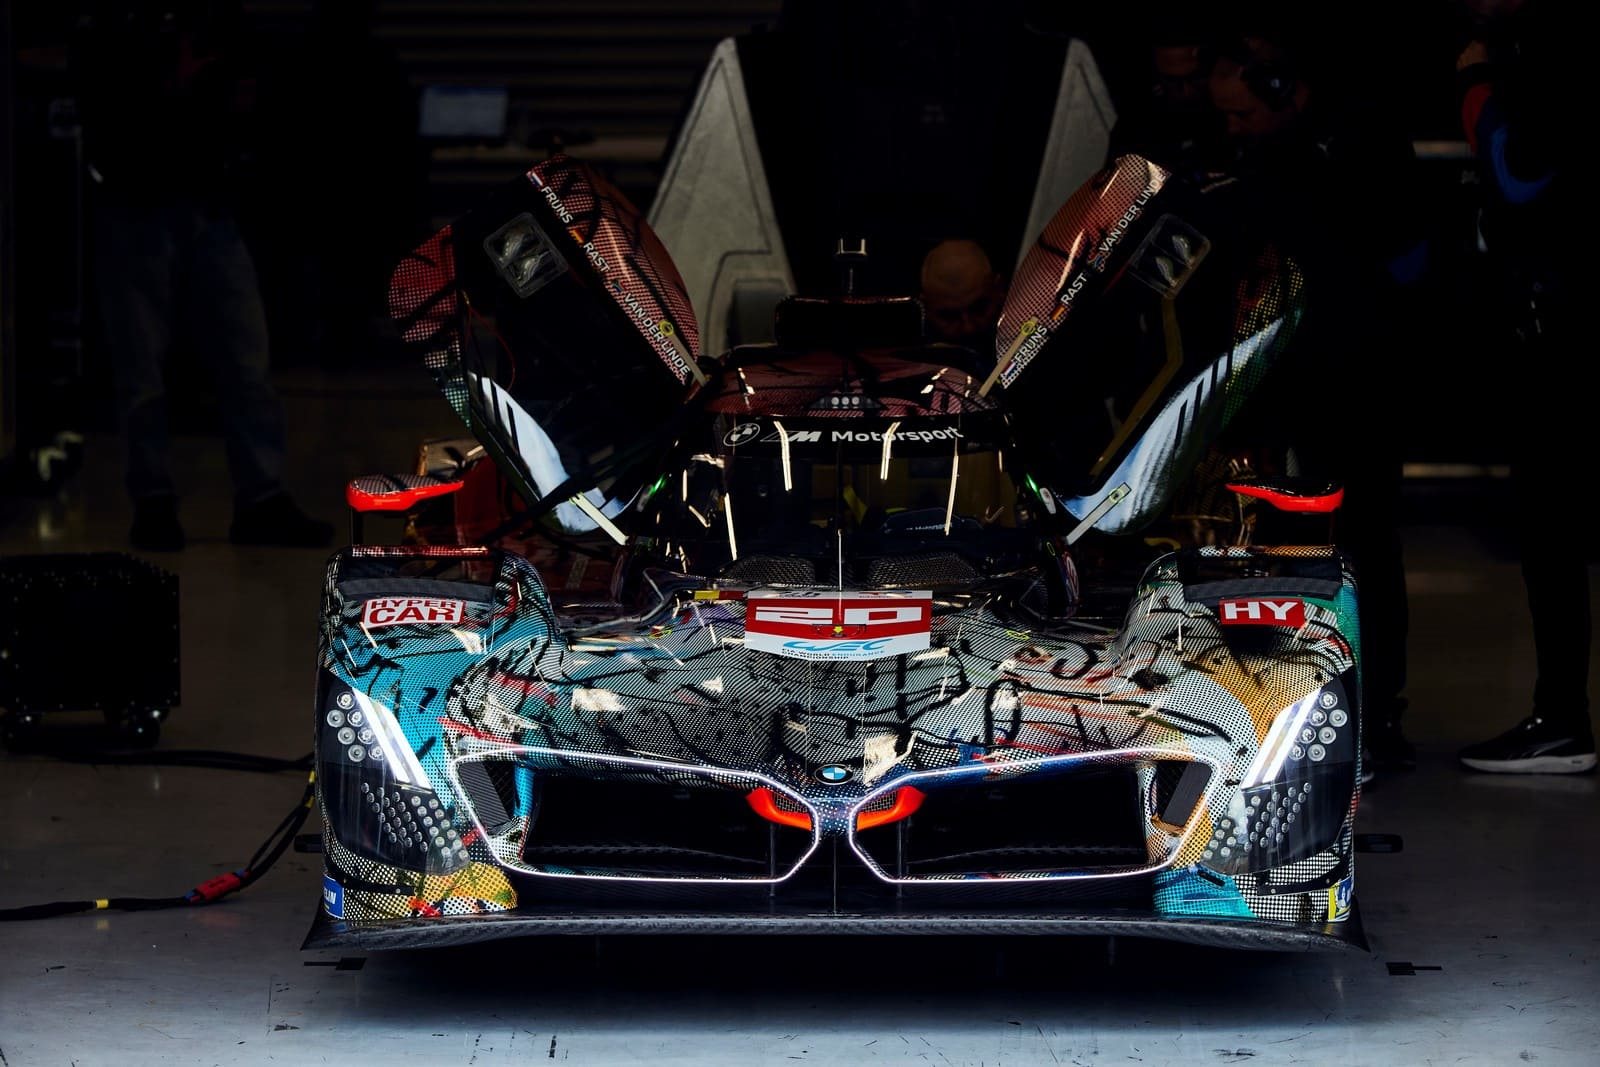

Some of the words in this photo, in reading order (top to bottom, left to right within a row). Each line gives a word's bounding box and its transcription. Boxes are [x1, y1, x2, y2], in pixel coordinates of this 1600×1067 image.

[1099, 229, 1121, 253] VAN
[1118, 204, 1141, 230] DER
[1135, 172, 1167, 206] LINDE
[583, 241, 611, 272] RAST
[1060, 272, 1088, 305] RAST
[624, 292, 646, 320] VAN
[642, 316, 665, 343] DER
[661, 340, 691, 376] LINDE
[831, 426, 964, 443] Motorsport
[371, 599, 458, 609] HYPER
[1224, 601, 1299, 621] HY
[369, 607, 456, 624] CAR
[755, 606, 922, 625] 20
[783, 638, 894, 652] WEC
[781, 651, 850, 660] CHAMPIONSHIP
